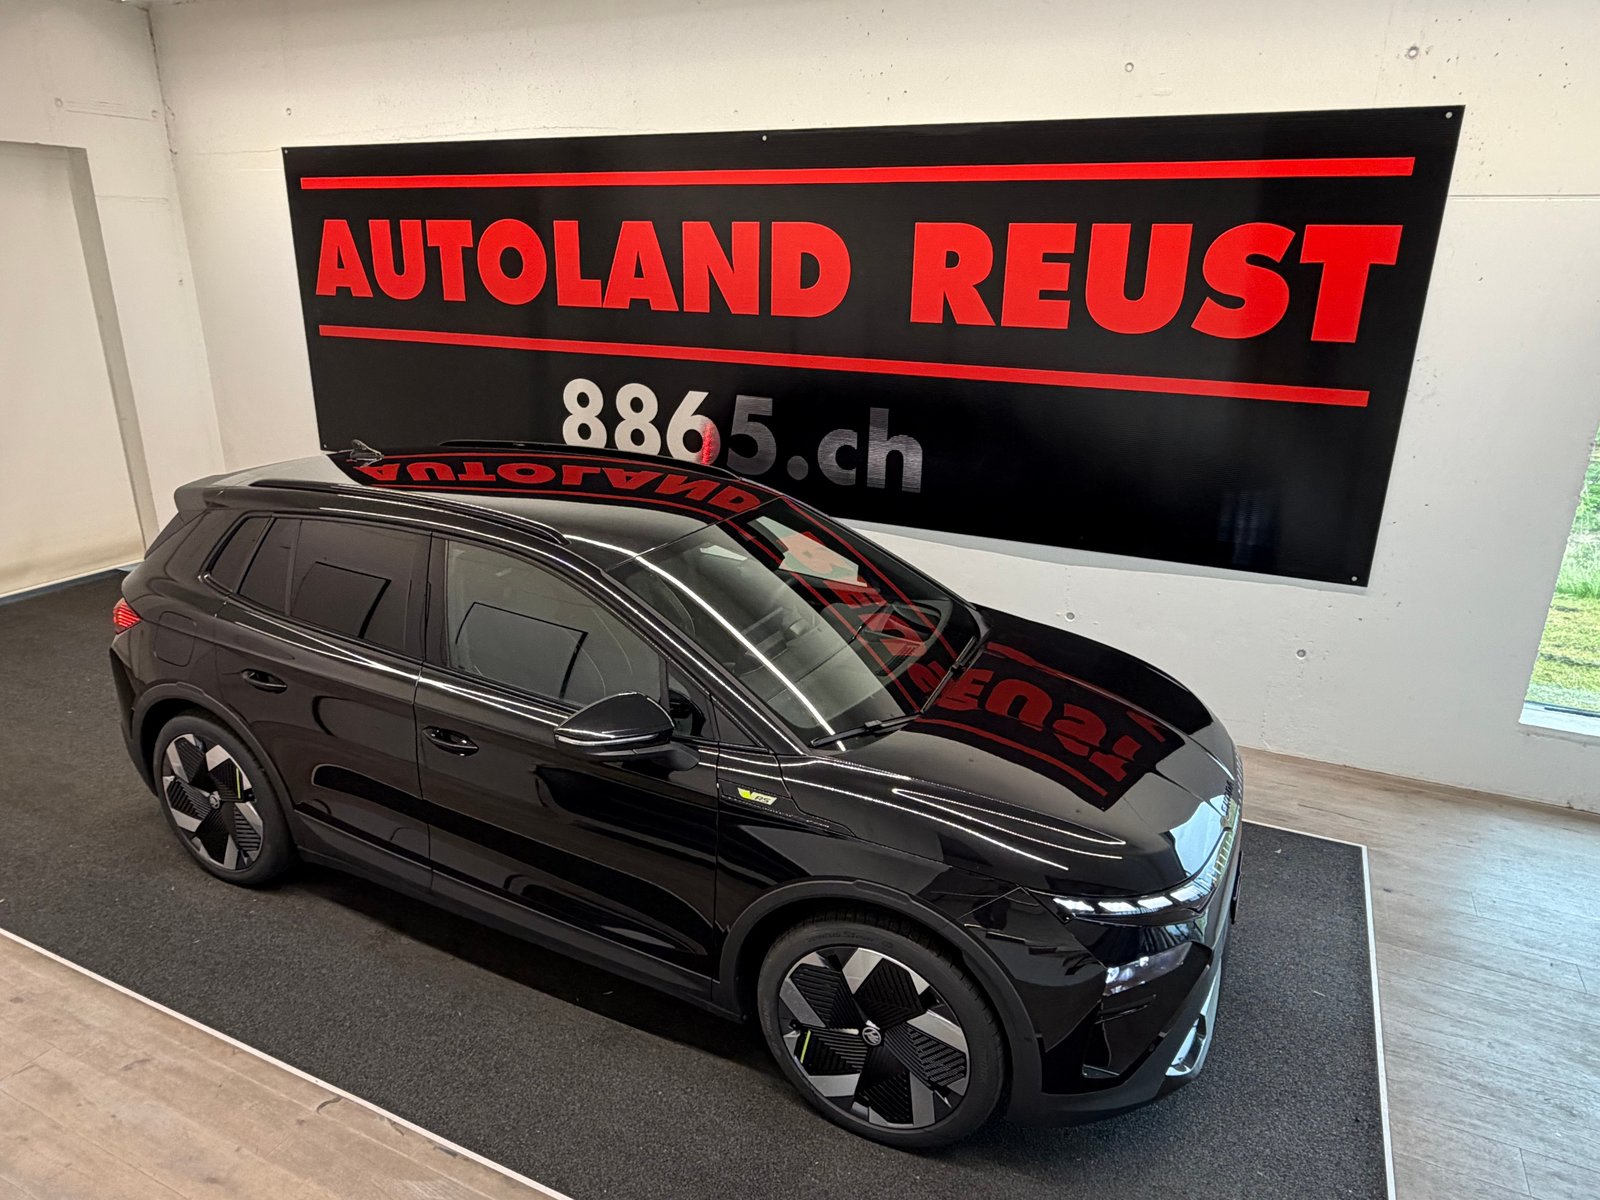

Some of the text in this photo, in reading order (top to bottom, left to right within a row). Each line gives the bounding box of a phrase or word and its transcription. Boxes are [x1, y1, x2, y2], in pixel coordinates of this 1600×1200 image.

[315, 218, 1404, 344] AUTOLAND REUST
[562, 378, 923, 493] 8865.ch
